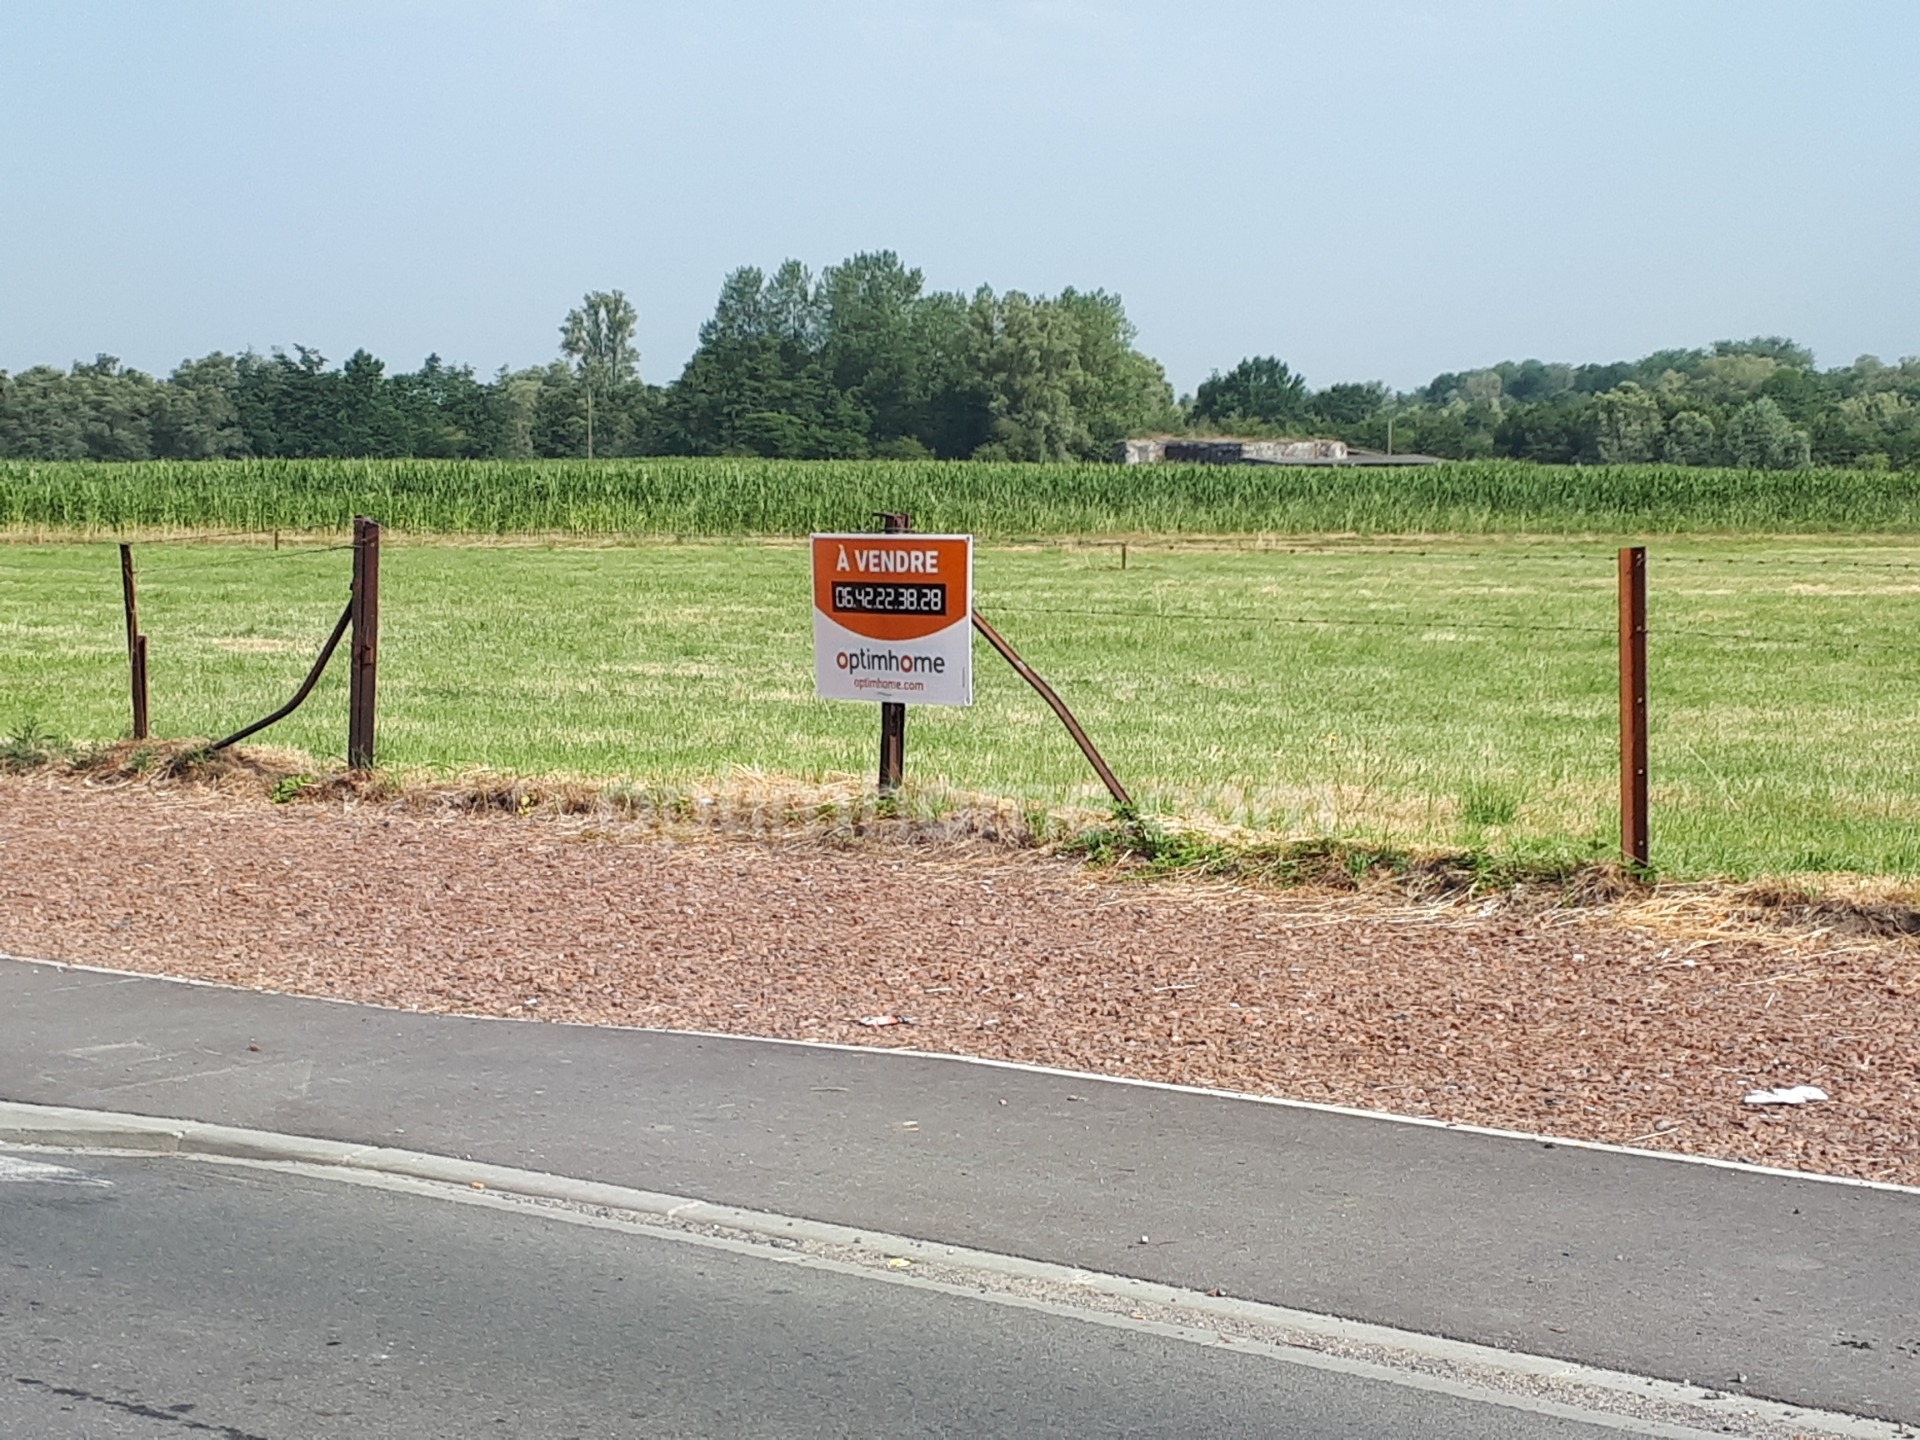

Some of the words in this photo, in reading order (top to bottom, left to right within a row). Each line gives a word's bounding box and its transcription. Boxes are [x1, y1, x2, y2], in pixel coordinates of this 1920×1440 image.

[836, 544, 850, 572] À
[854, 549, 939, 574] VENDRE
[835, 586, 942, 611] 06.42.22.38.28
[836, 648, 946, 675] optimhome
[853, 677, 924, 691] optimhome.com
